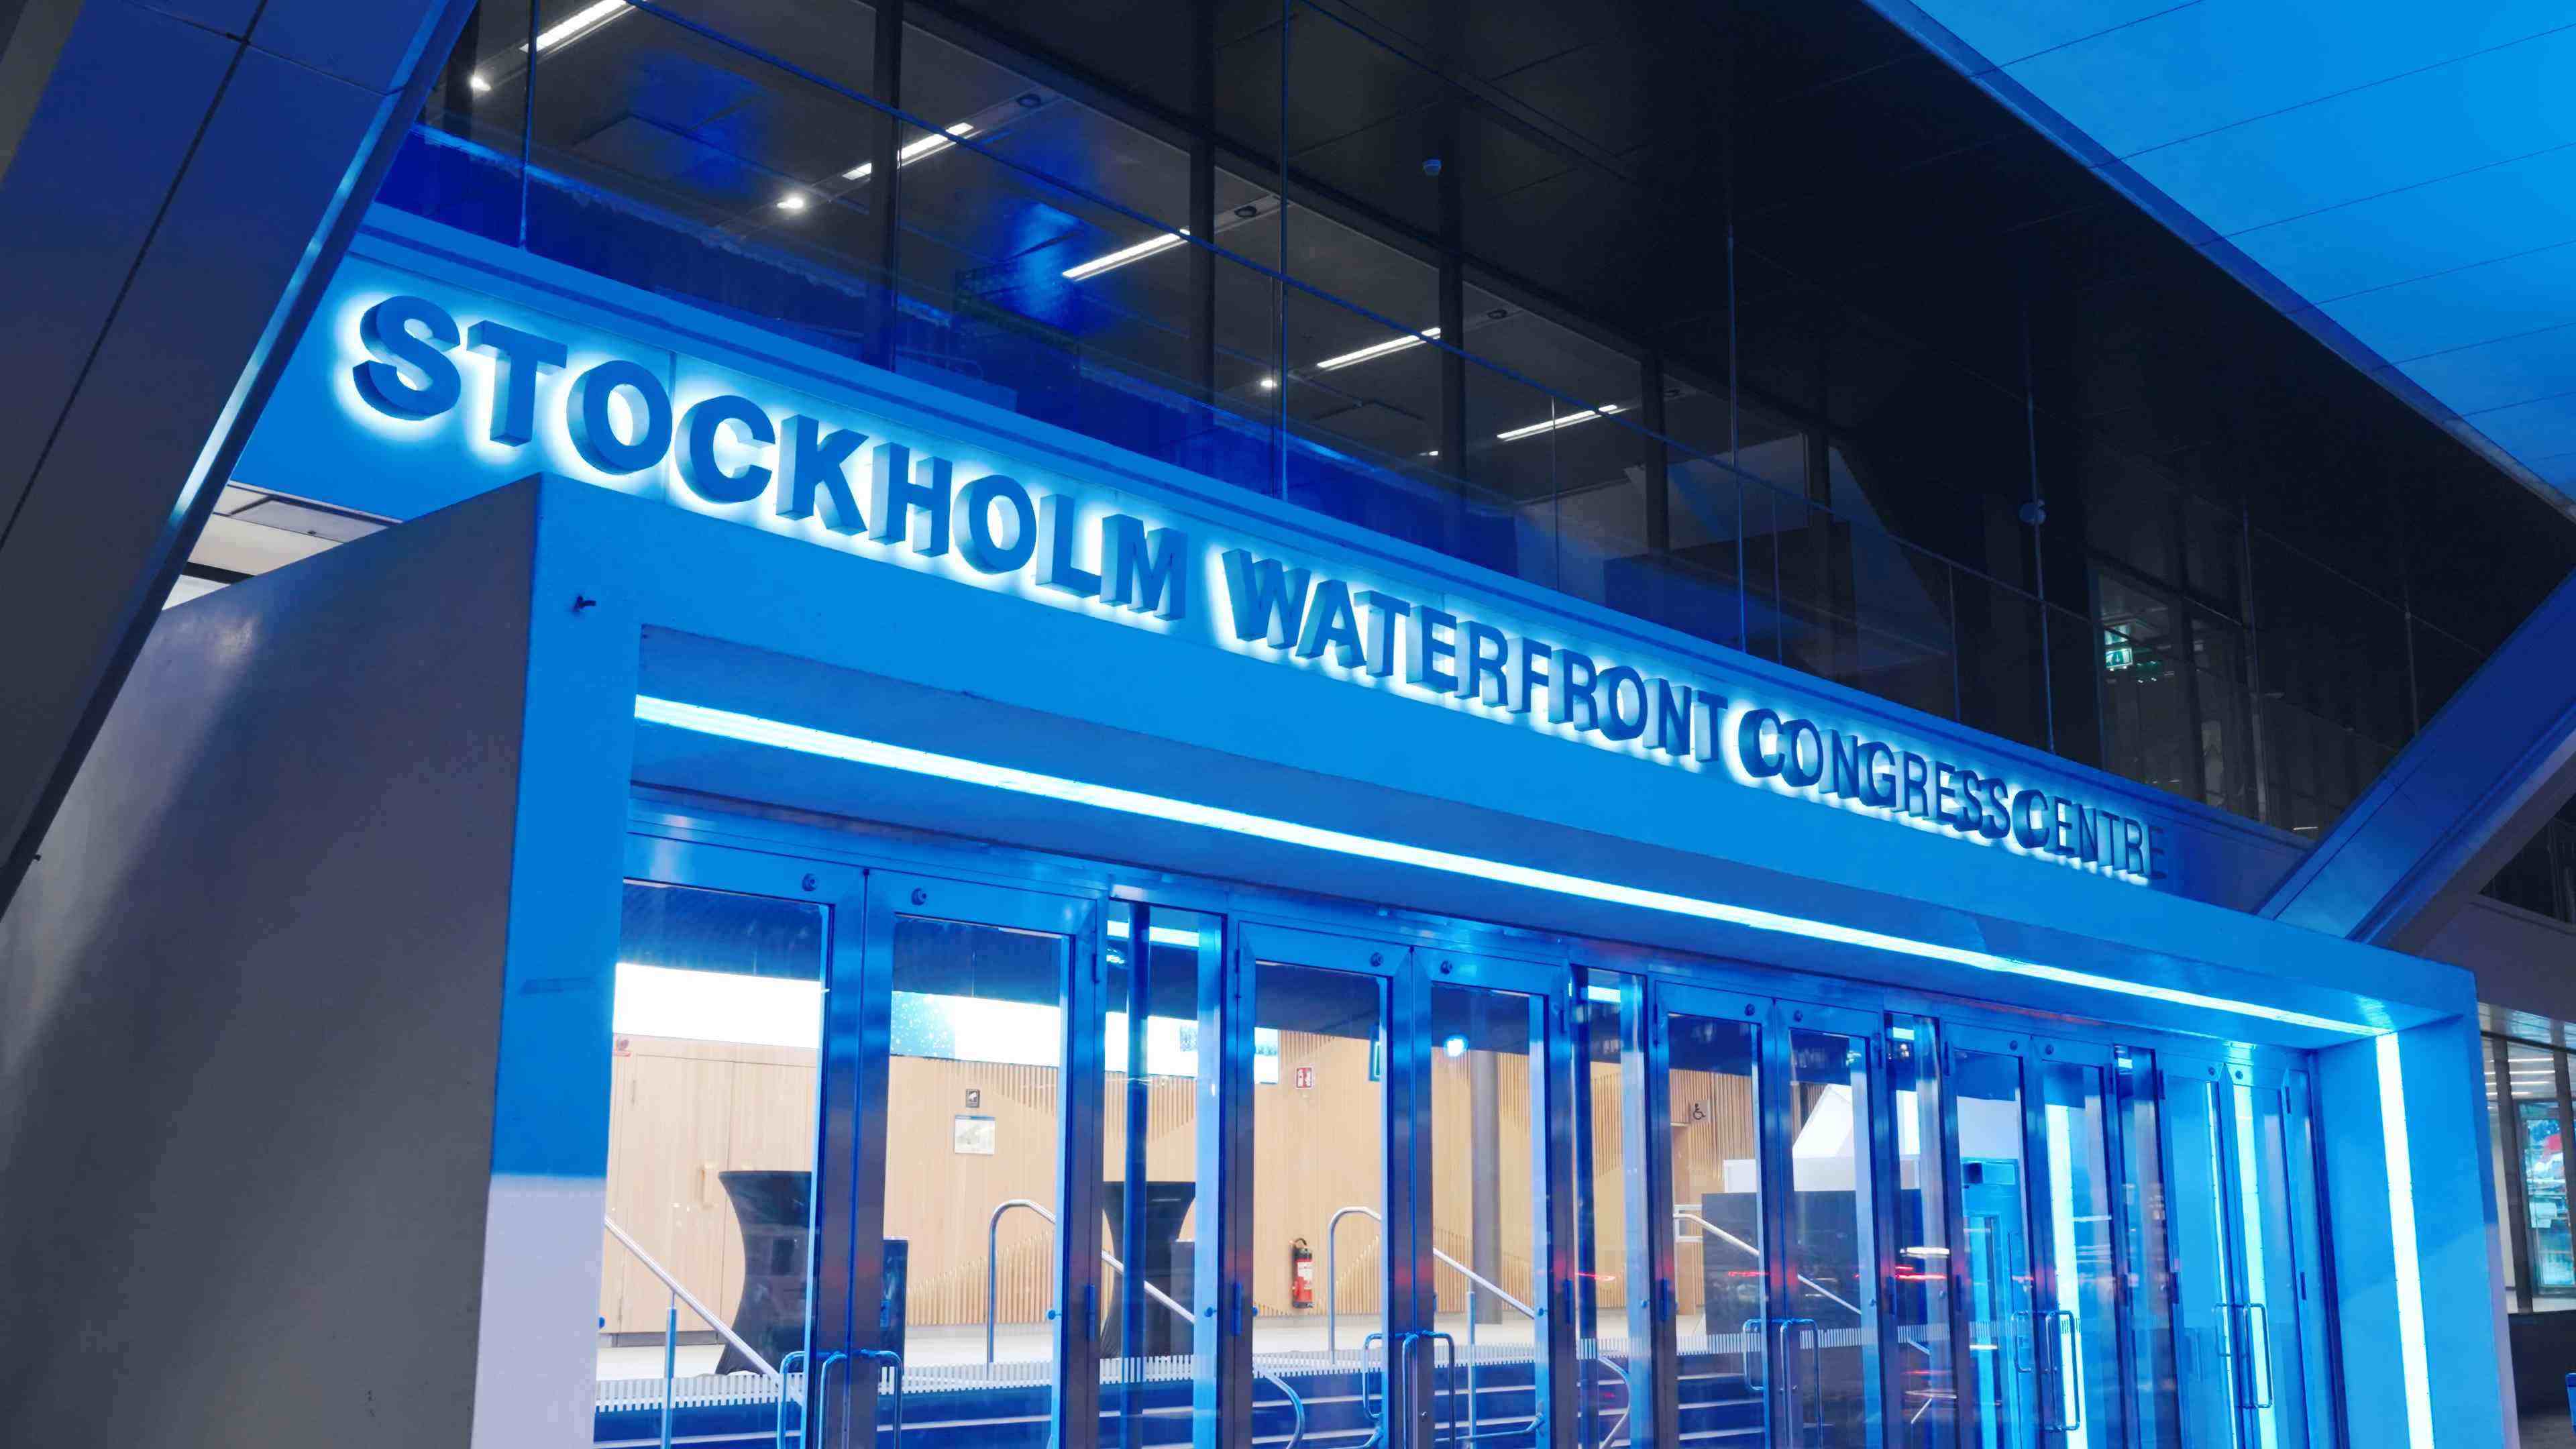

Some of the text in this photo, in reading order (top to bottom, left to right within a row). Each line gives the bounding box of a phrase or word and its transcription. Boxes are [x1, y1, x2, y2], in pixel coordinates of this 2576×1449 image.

[353, 296, 2166, 879] STOCKHOLM WATERFRONT CONGRESS CENTRE
